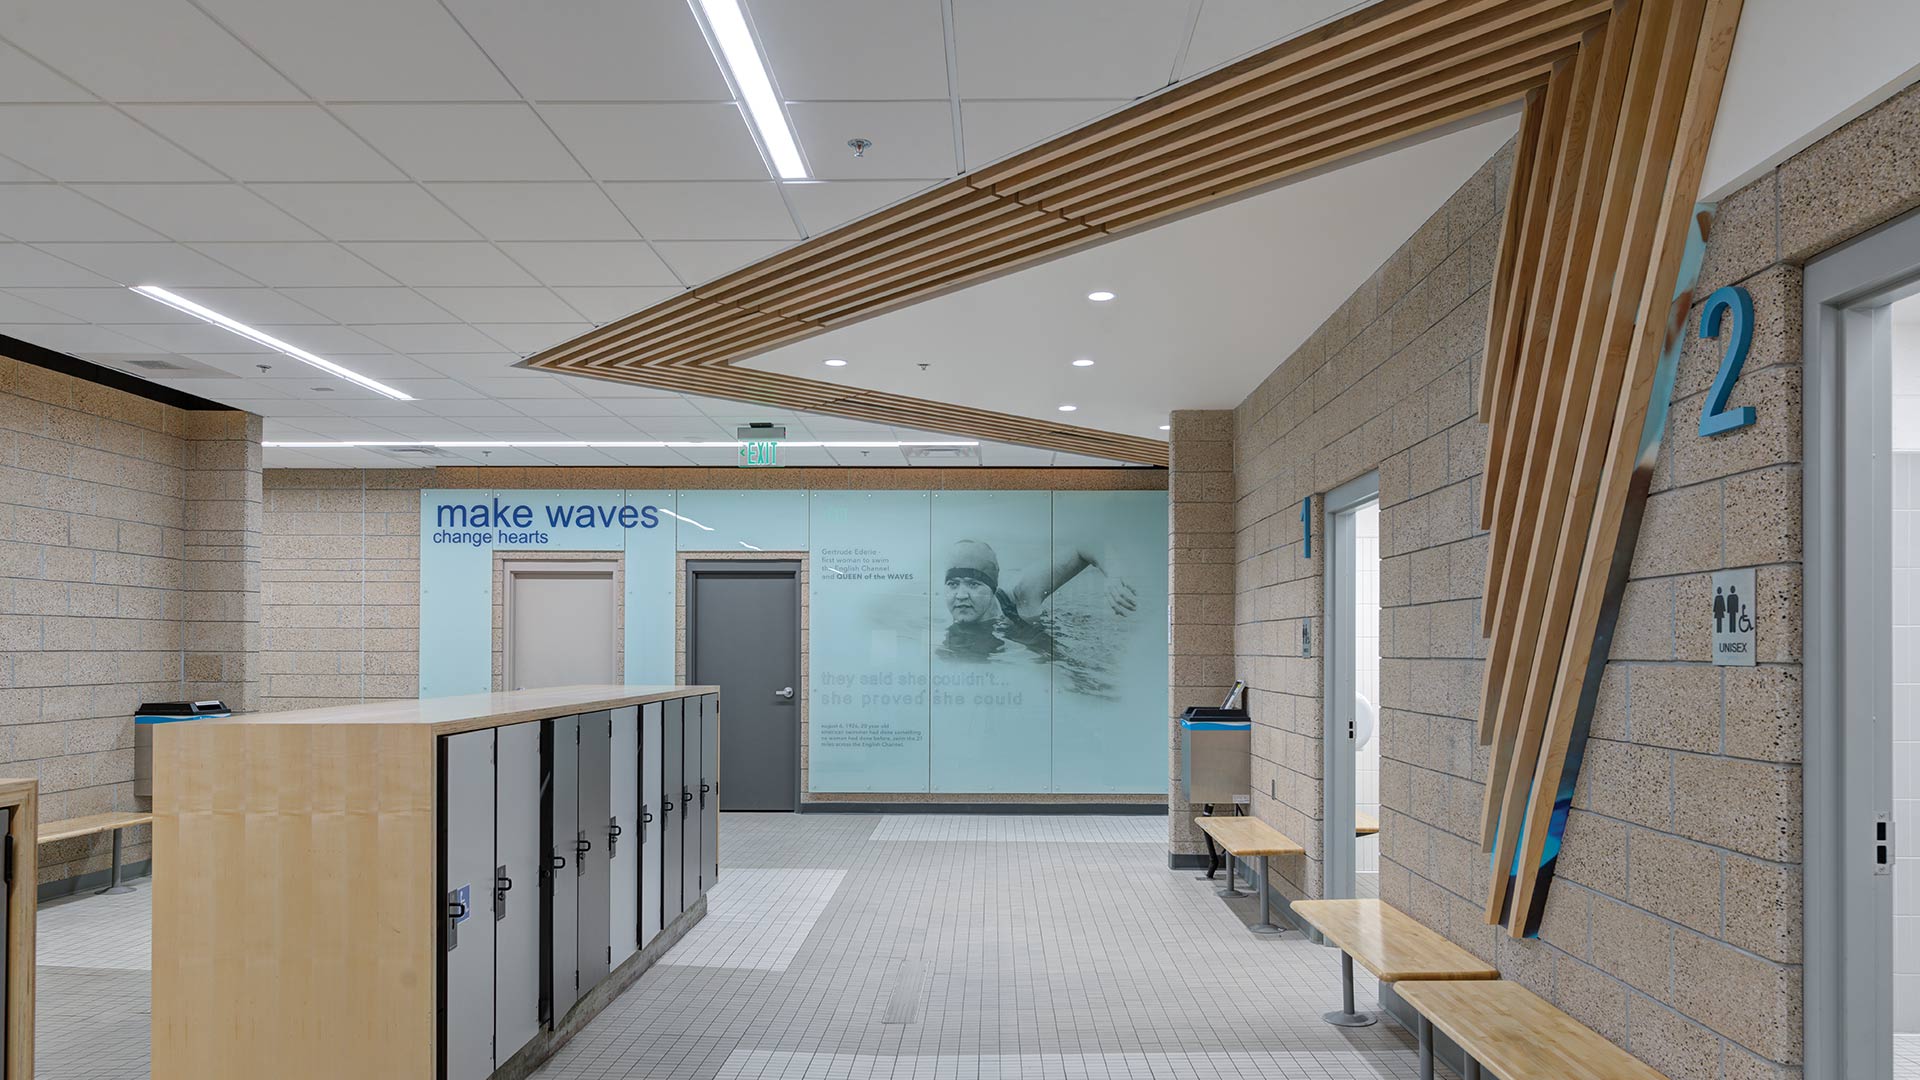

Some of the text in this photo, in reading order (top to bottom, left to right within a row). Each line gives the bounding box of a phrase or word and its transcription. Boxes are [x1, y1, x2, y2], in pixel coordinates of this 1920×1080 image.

[1698, 286, 1757, 437] 2
[747, 441, 778, 465] EXIT
[437, 498, 659, 529] make waves
[1300, 496, 1311, 558] 1
[433, 530, 549, 547] change hearts
[821, 548, 853, 556] Gertrude
[834, 566, 860, 574] English
[1719, 643, 1747, 653] UNISEX
[820, 671, 855, 688] they
[859, 671, 893, 686] said
[897, 671, 927, 686] she
[821, 691, 1023, 708] she proved she could
